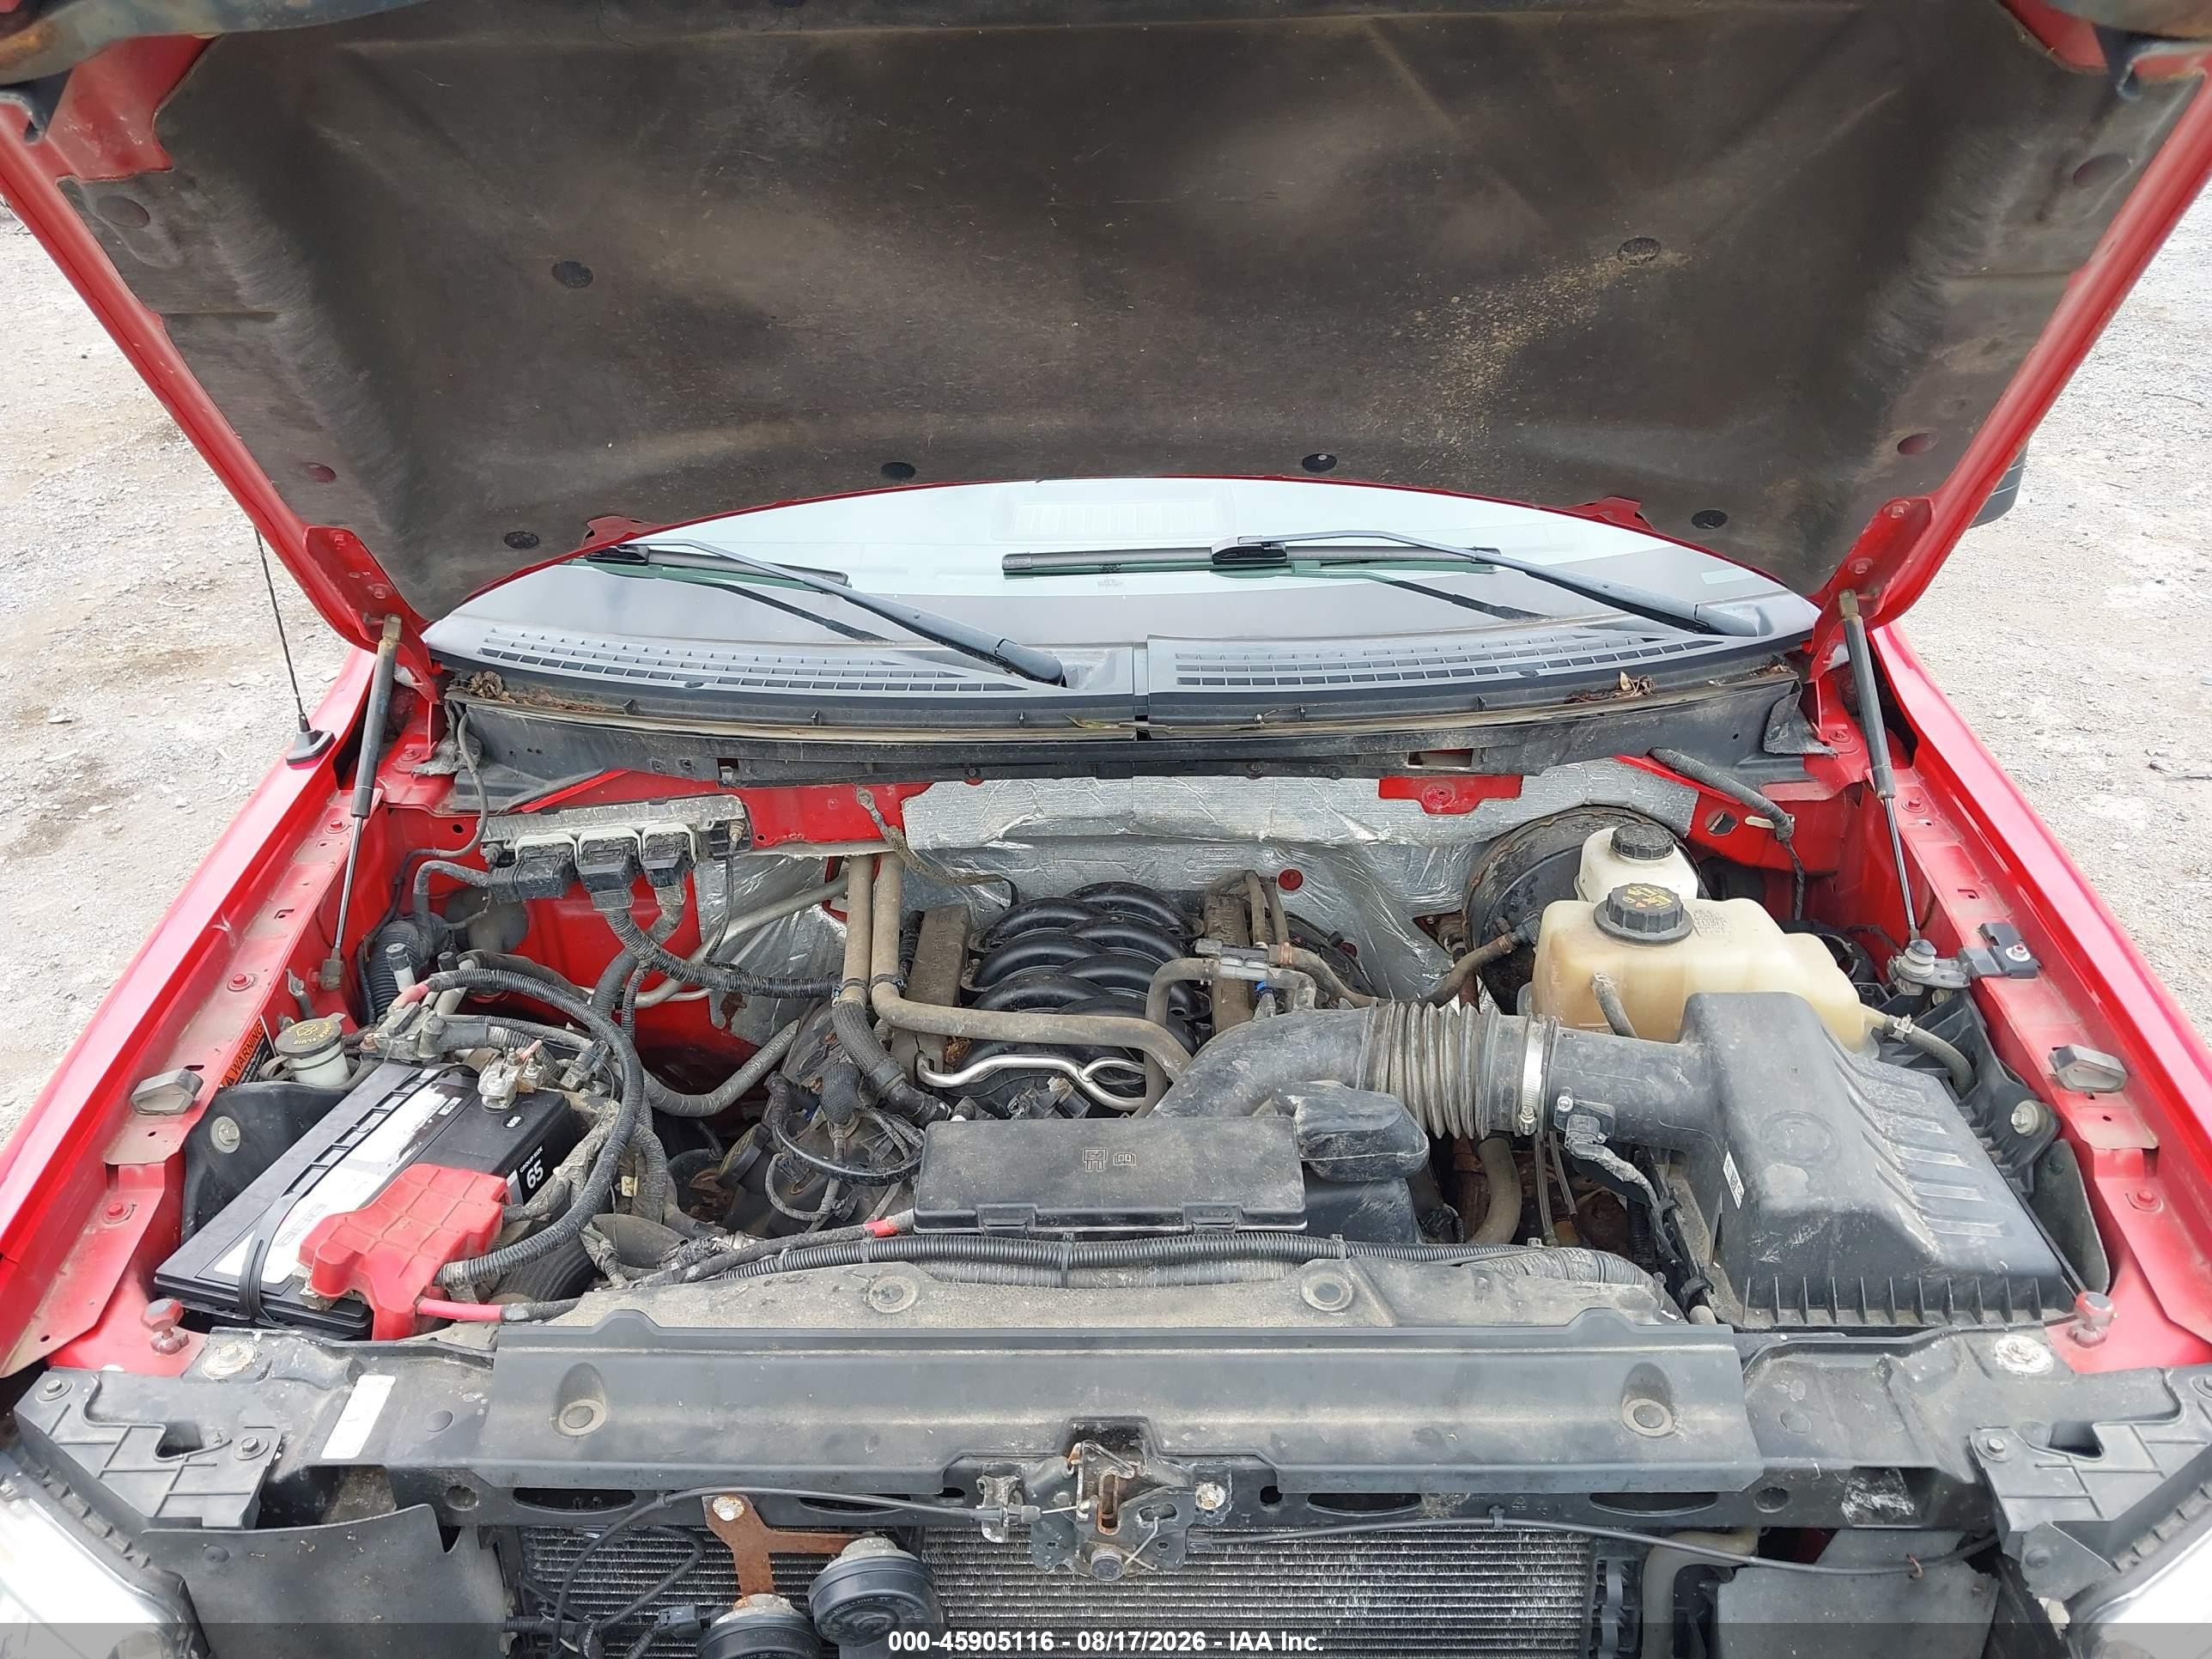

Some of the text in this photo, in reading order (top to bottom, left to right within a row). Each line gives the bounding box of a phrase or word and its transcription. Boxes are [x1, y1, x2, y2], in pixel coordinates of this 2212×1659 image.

[229, 1023, 264, 1076] WARNING
[520, 1146, 544, 1174] GROUP SIZE
[526, 1158, 544, 1189] 65
